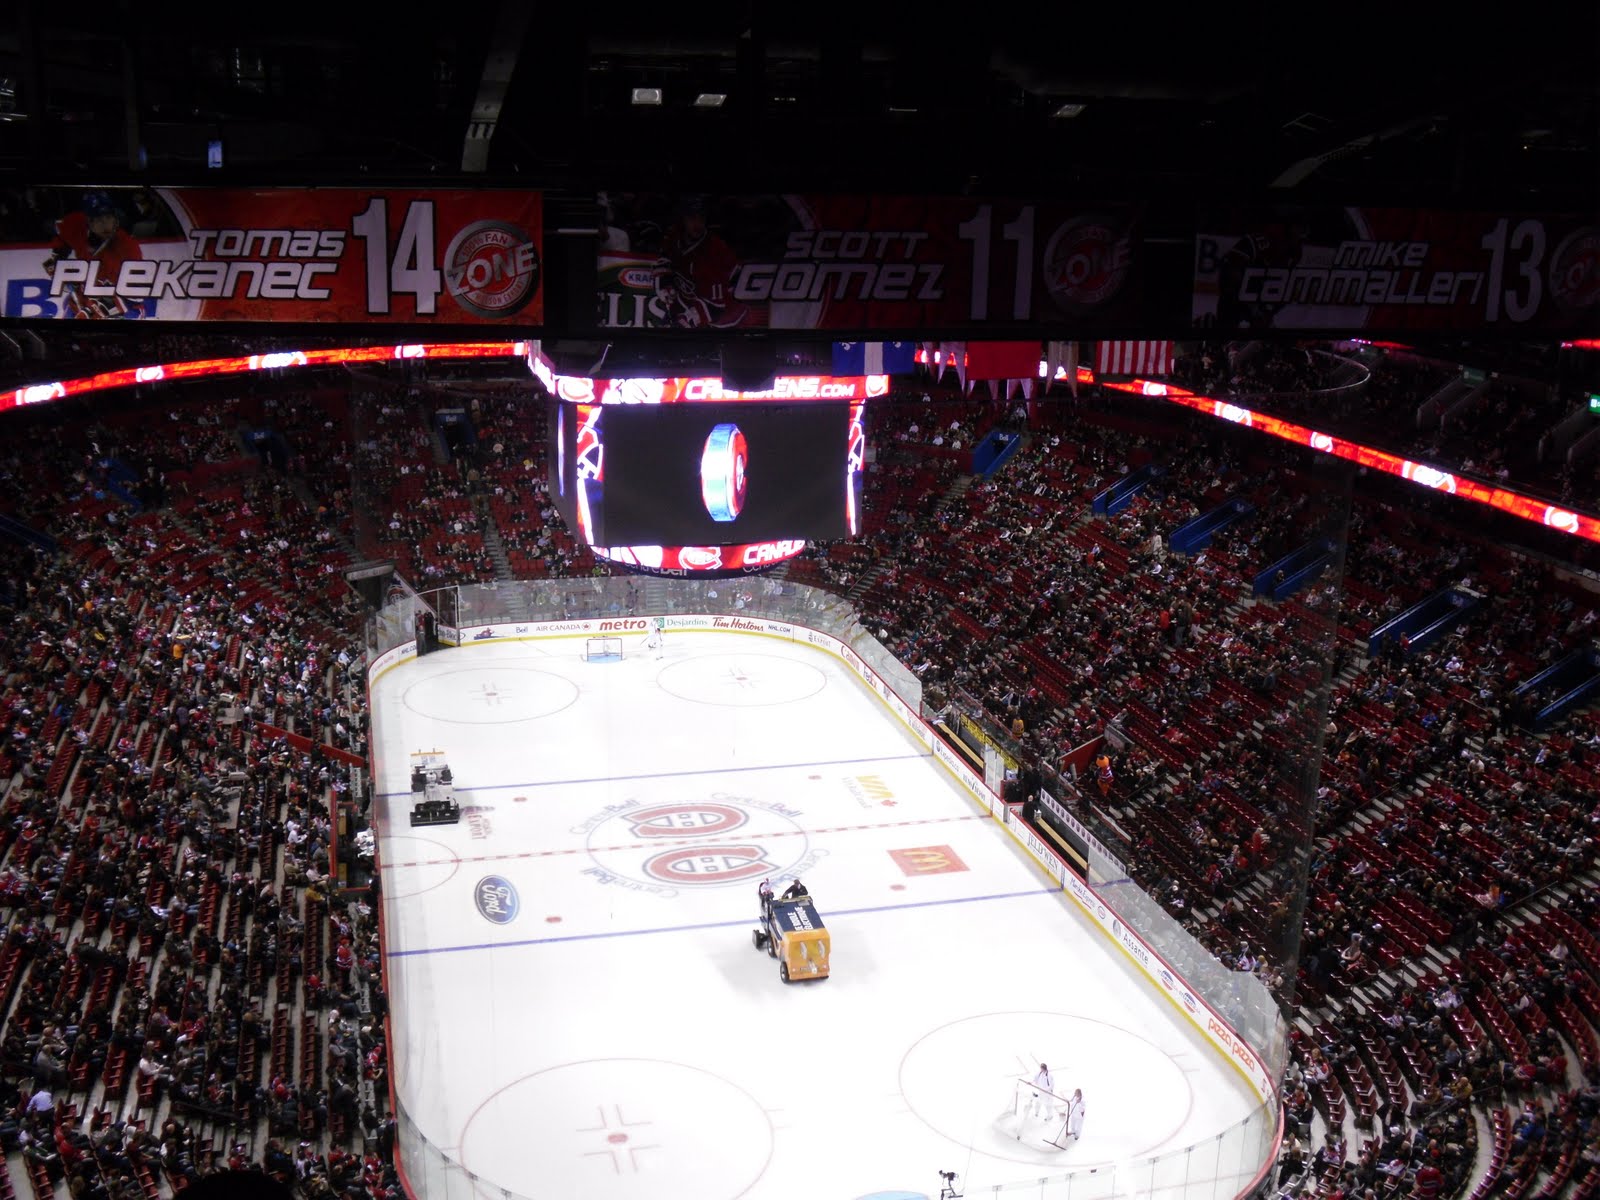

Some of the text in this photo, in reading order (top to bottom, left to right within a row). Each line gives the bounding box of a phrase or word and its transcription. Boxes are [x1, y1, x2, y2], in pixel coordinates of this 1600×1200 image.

[485, 233, 508, 244] FAN
[784, 231, 929, 259] SCOTT
[352, 198, 443, 315] 14
[958, 205, 1038, 321] 11
[627, 272, 656, 283] KRAF
[1482, 217, 1549, 323] 13
[515, 626, 529, 634] Bell
[550, 624, 581, 632] CANADA
[599, 619, 647, 631] metro
[666, 618, 708, 627] Desjardins
[712, 616, 764, 632] Tim Hortons
[767, 625, 791, 633] NHL.COM
[482, 884, 512, 915] Ford
[1122, 932, 1149, 965] Assante
[1208, 1017, 1256, 1072] pizza pizza
